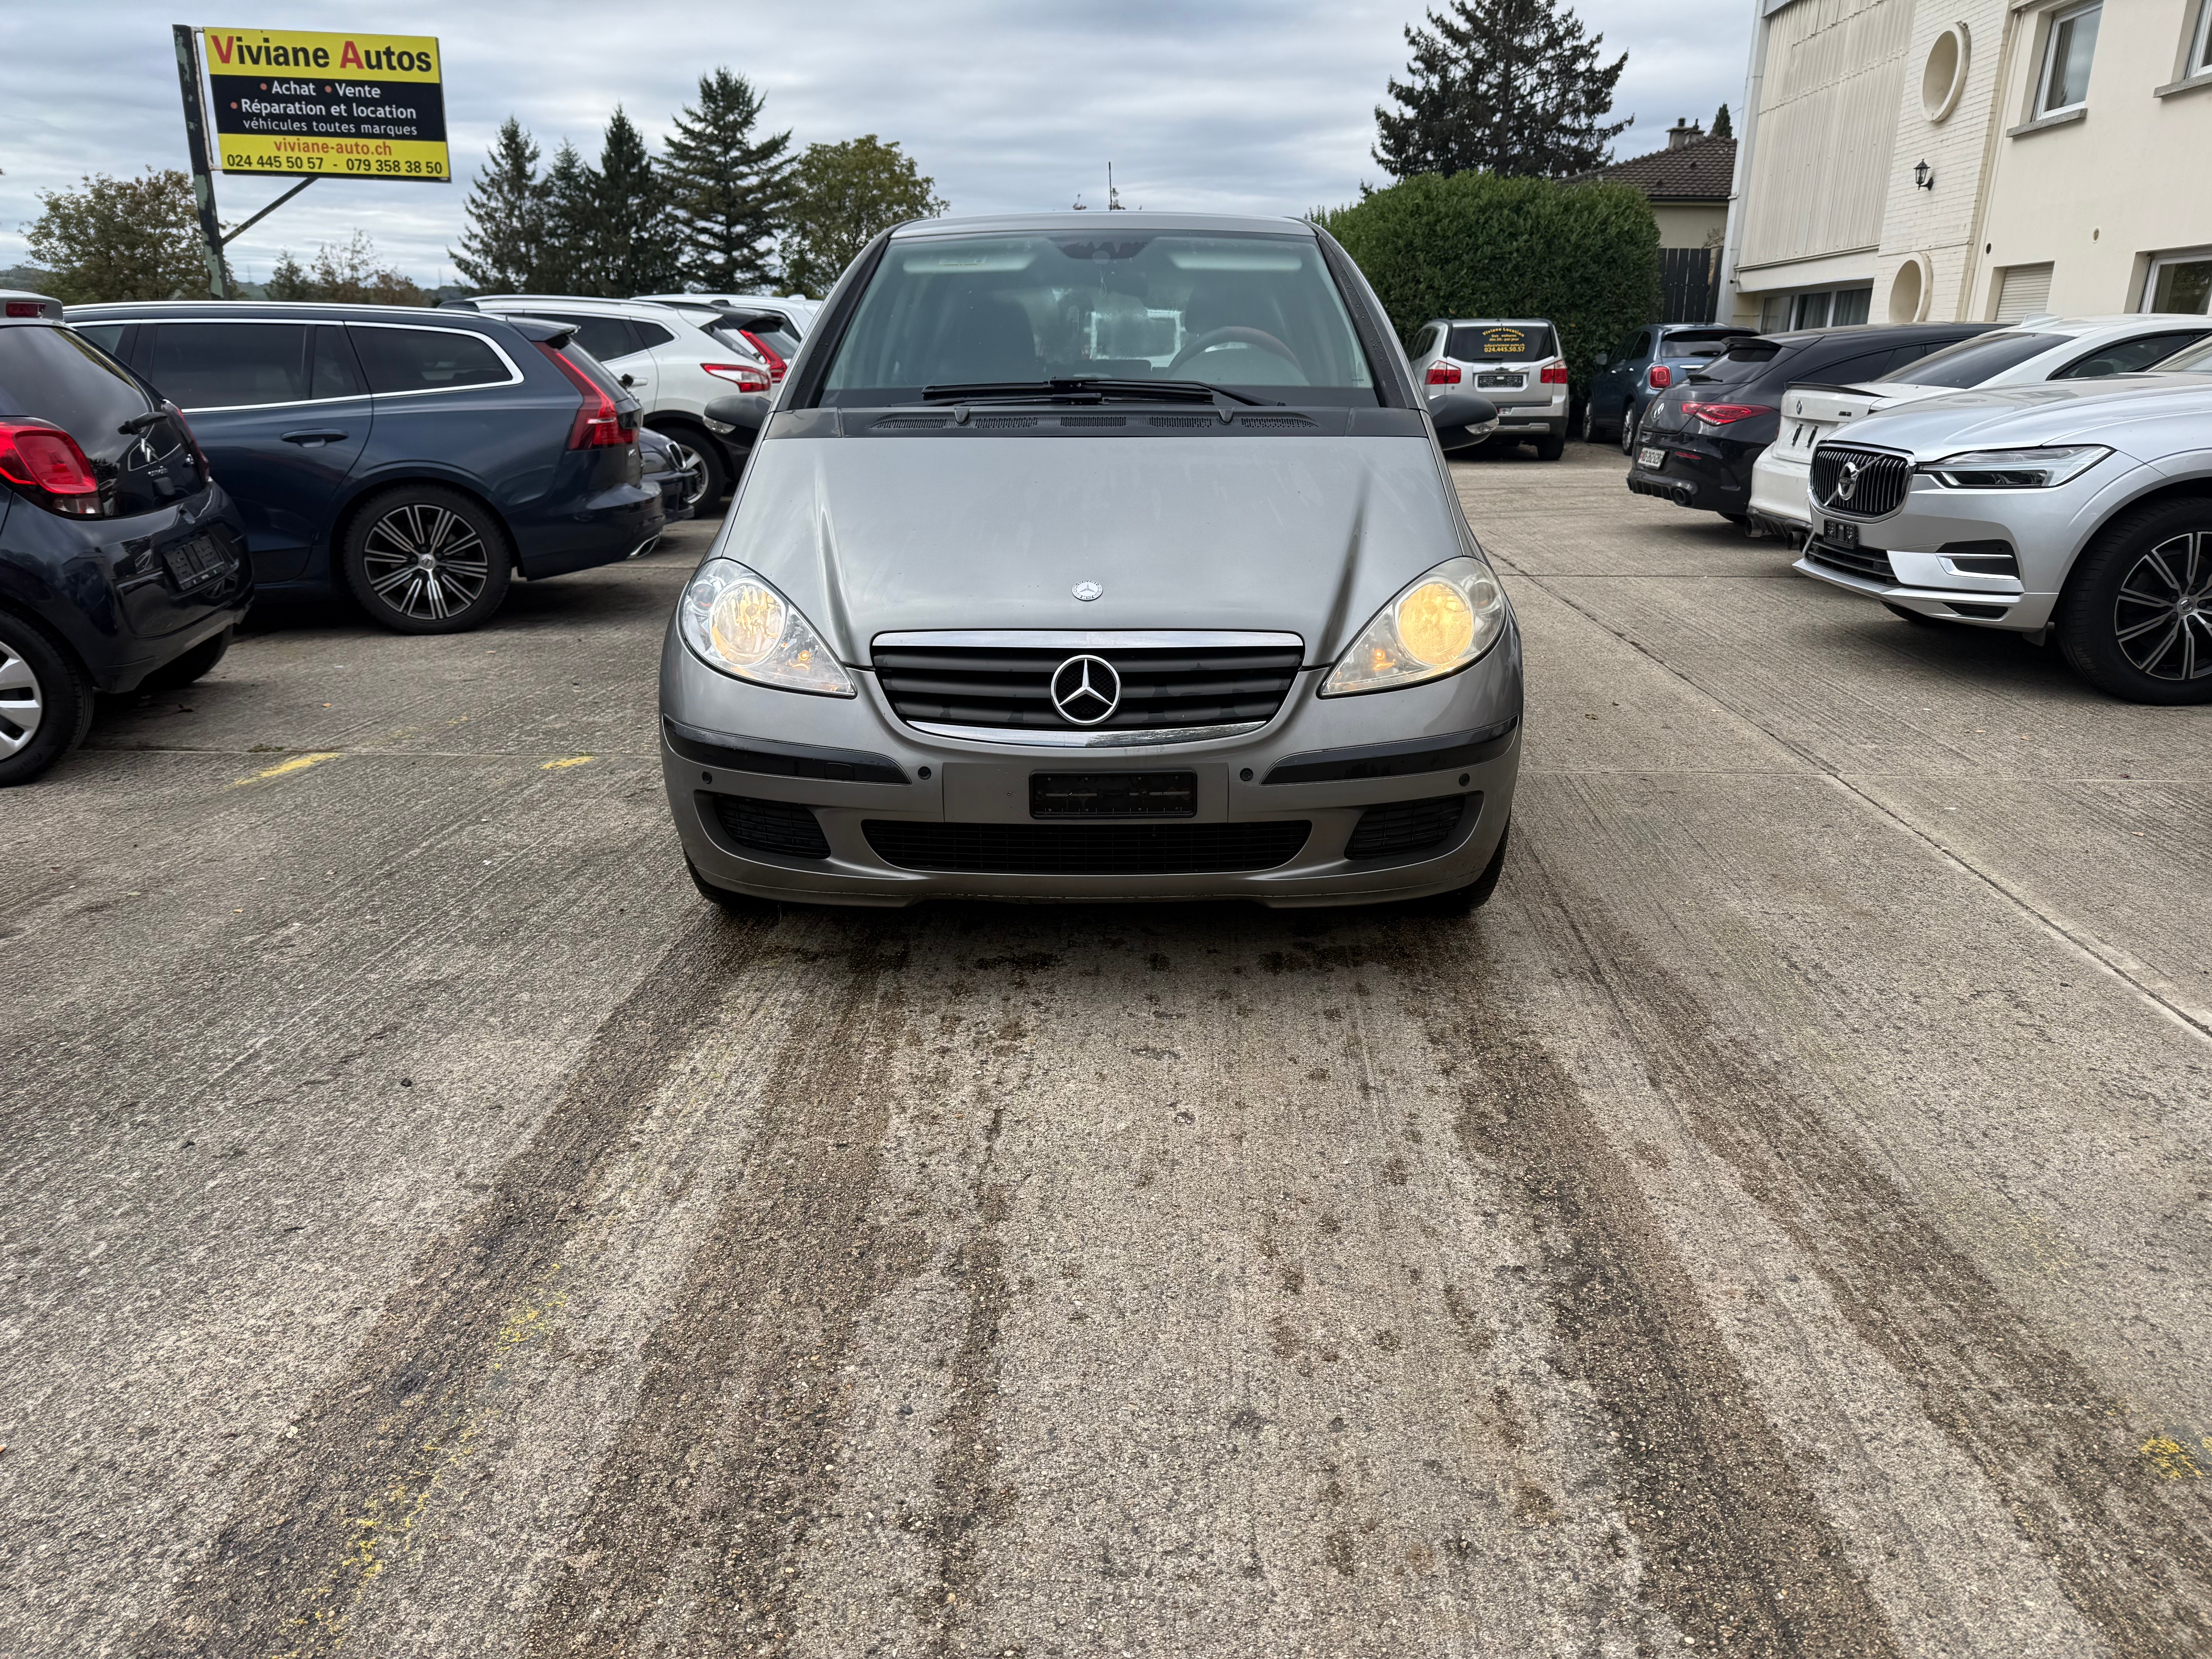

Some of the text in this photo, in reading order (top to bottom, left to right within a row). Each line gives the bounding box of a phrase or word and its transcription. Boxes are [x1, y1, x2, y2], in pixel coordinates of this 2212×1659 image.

[210, 35, 432, 72] Viviane Autos
[271, 81, 381, 98] Achat Vente
[241, 98, 416, 119] Réparation et location
[243, 117, 417, 136] véhicules toutes marques
[274, 138, 392, 156] viviane-auto.ch
[227, 154, 252, 167] 024
[257, 155, 282, 168] 445
[286, 156, 303, 169] 50
[307, 157, 323, 170] 57
[346, 158, 371, 171] 079
[375, 159, 401, 173] 358
[405, 160, 422, 173] 38
[426, 161, 442, 174] 50
